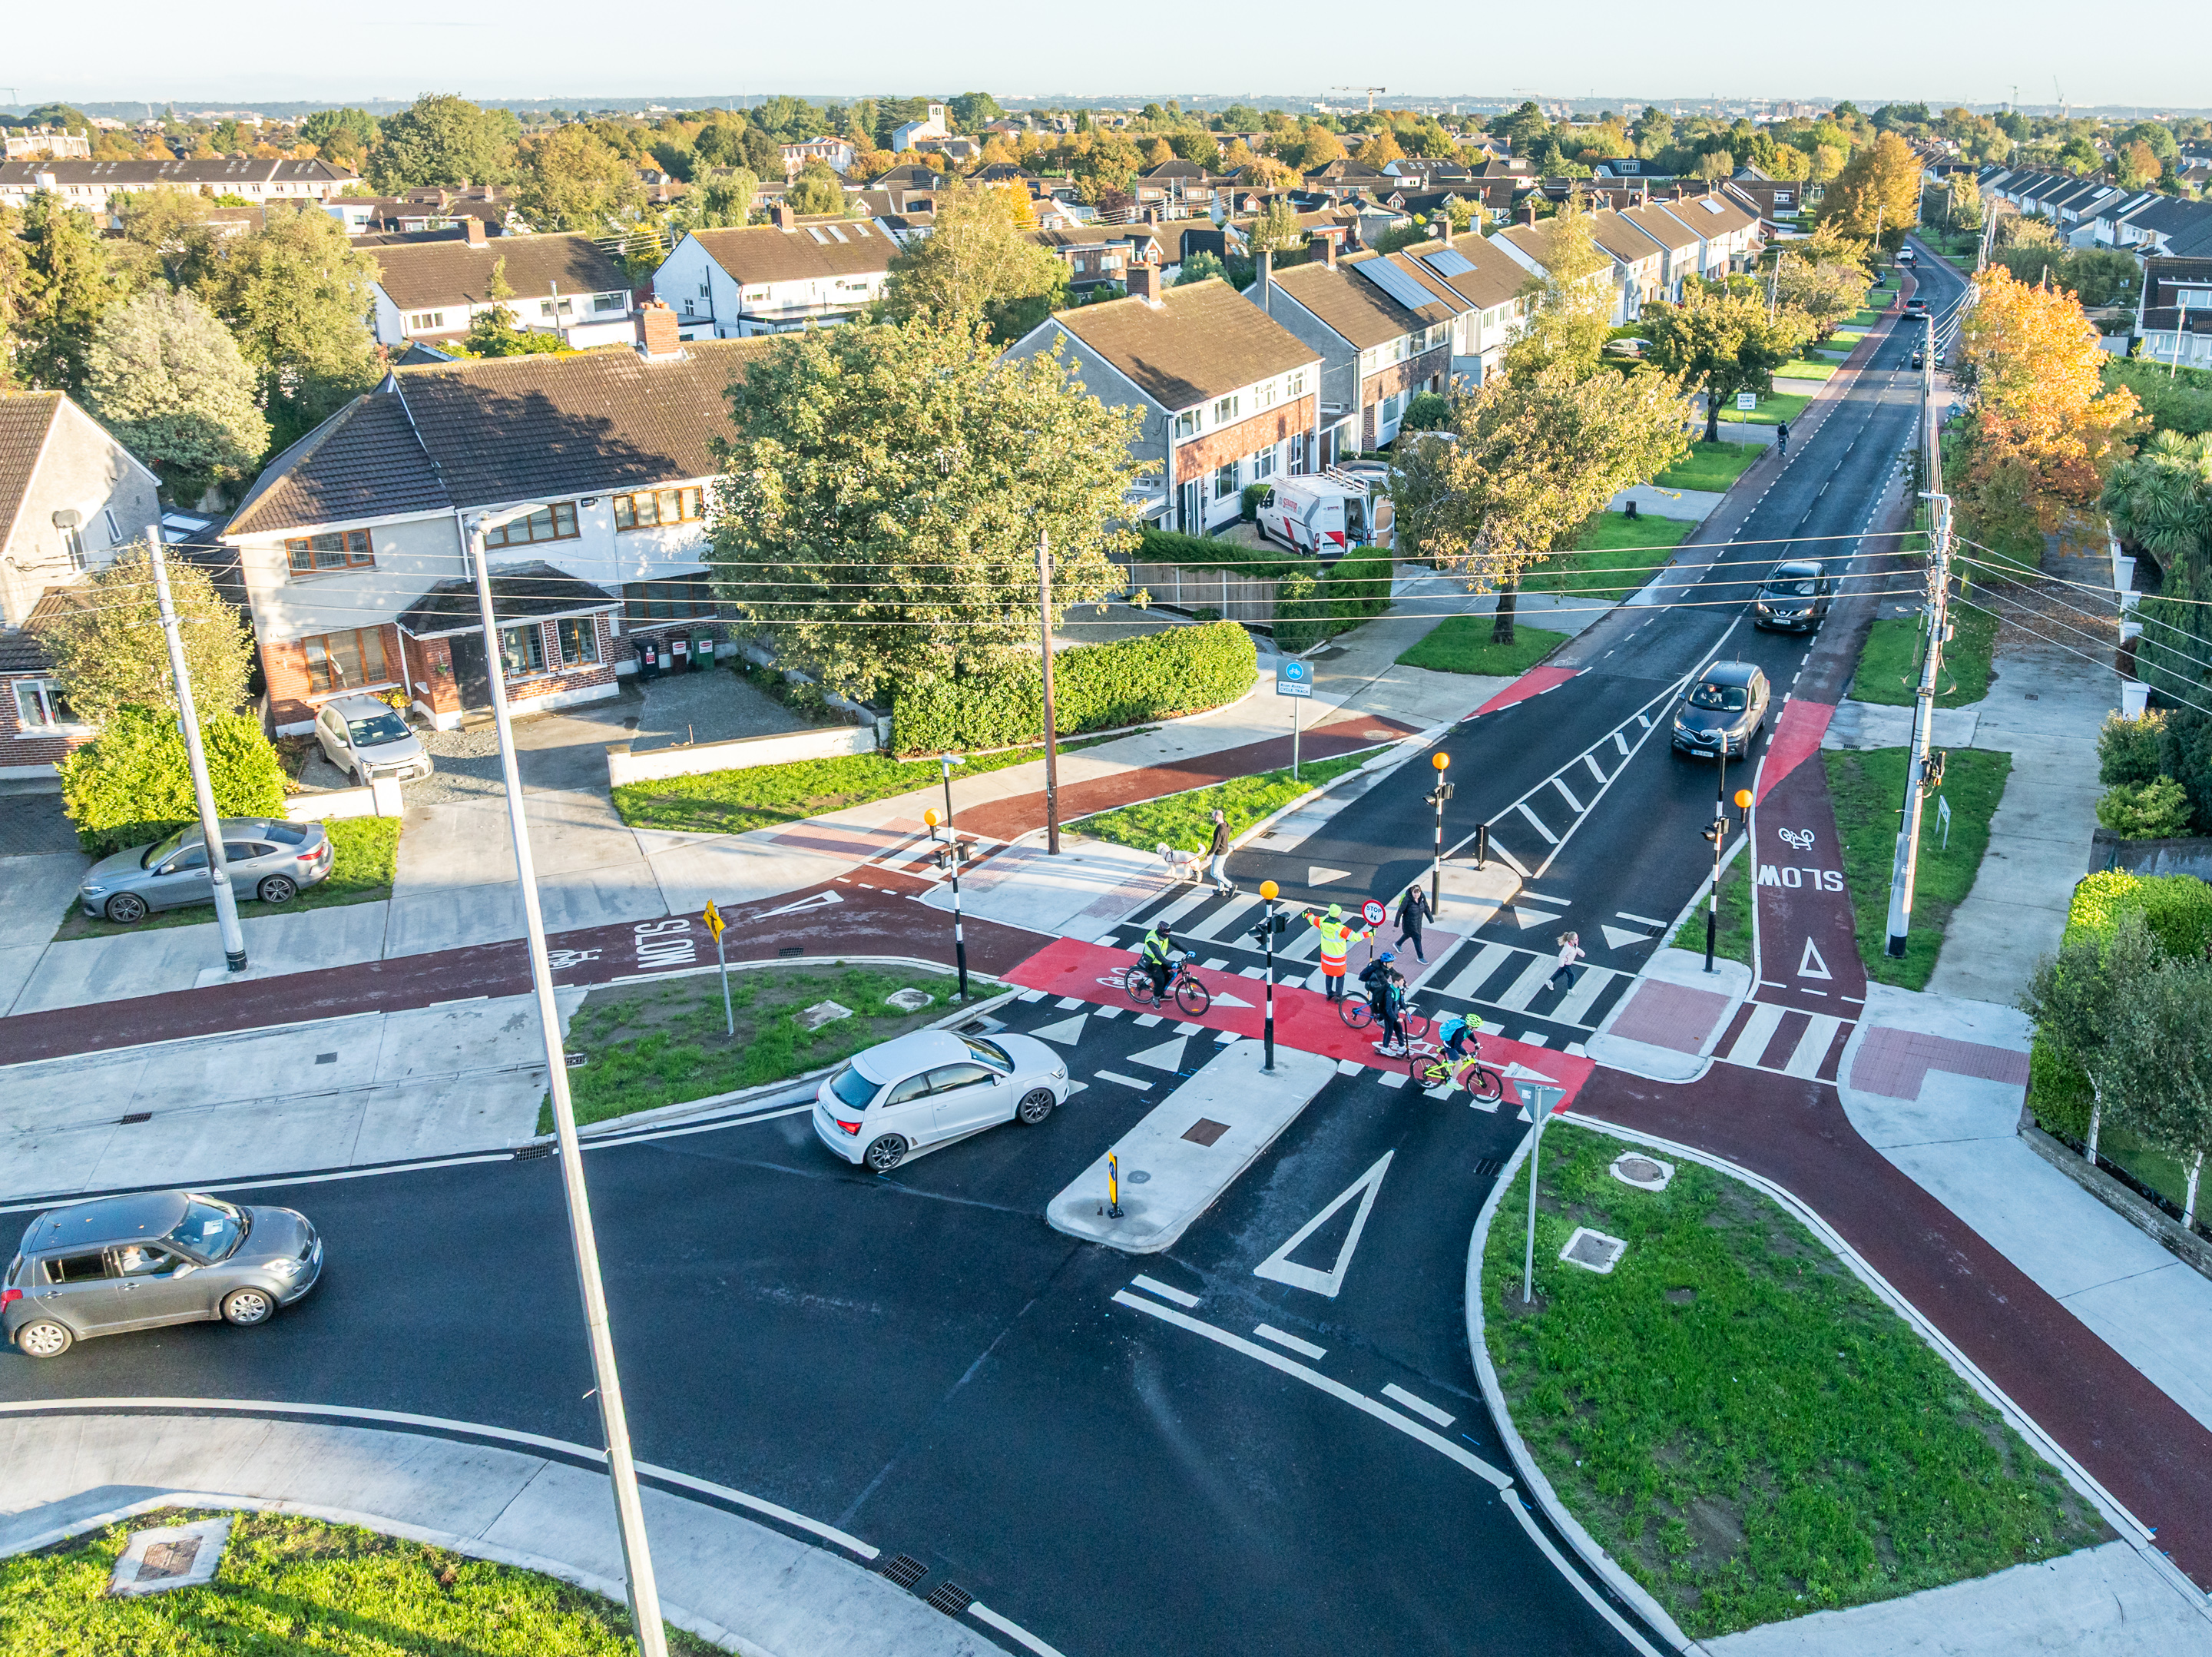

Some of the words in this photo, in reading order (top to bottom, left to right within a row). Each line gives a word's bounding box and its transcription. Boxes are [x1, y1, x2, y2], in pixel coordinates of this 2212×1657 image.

[1757, 864, 1844, 892] SLOW
[1366, 905, 1382, 913] STOP
[634, 919, 697, 969] SLOW
